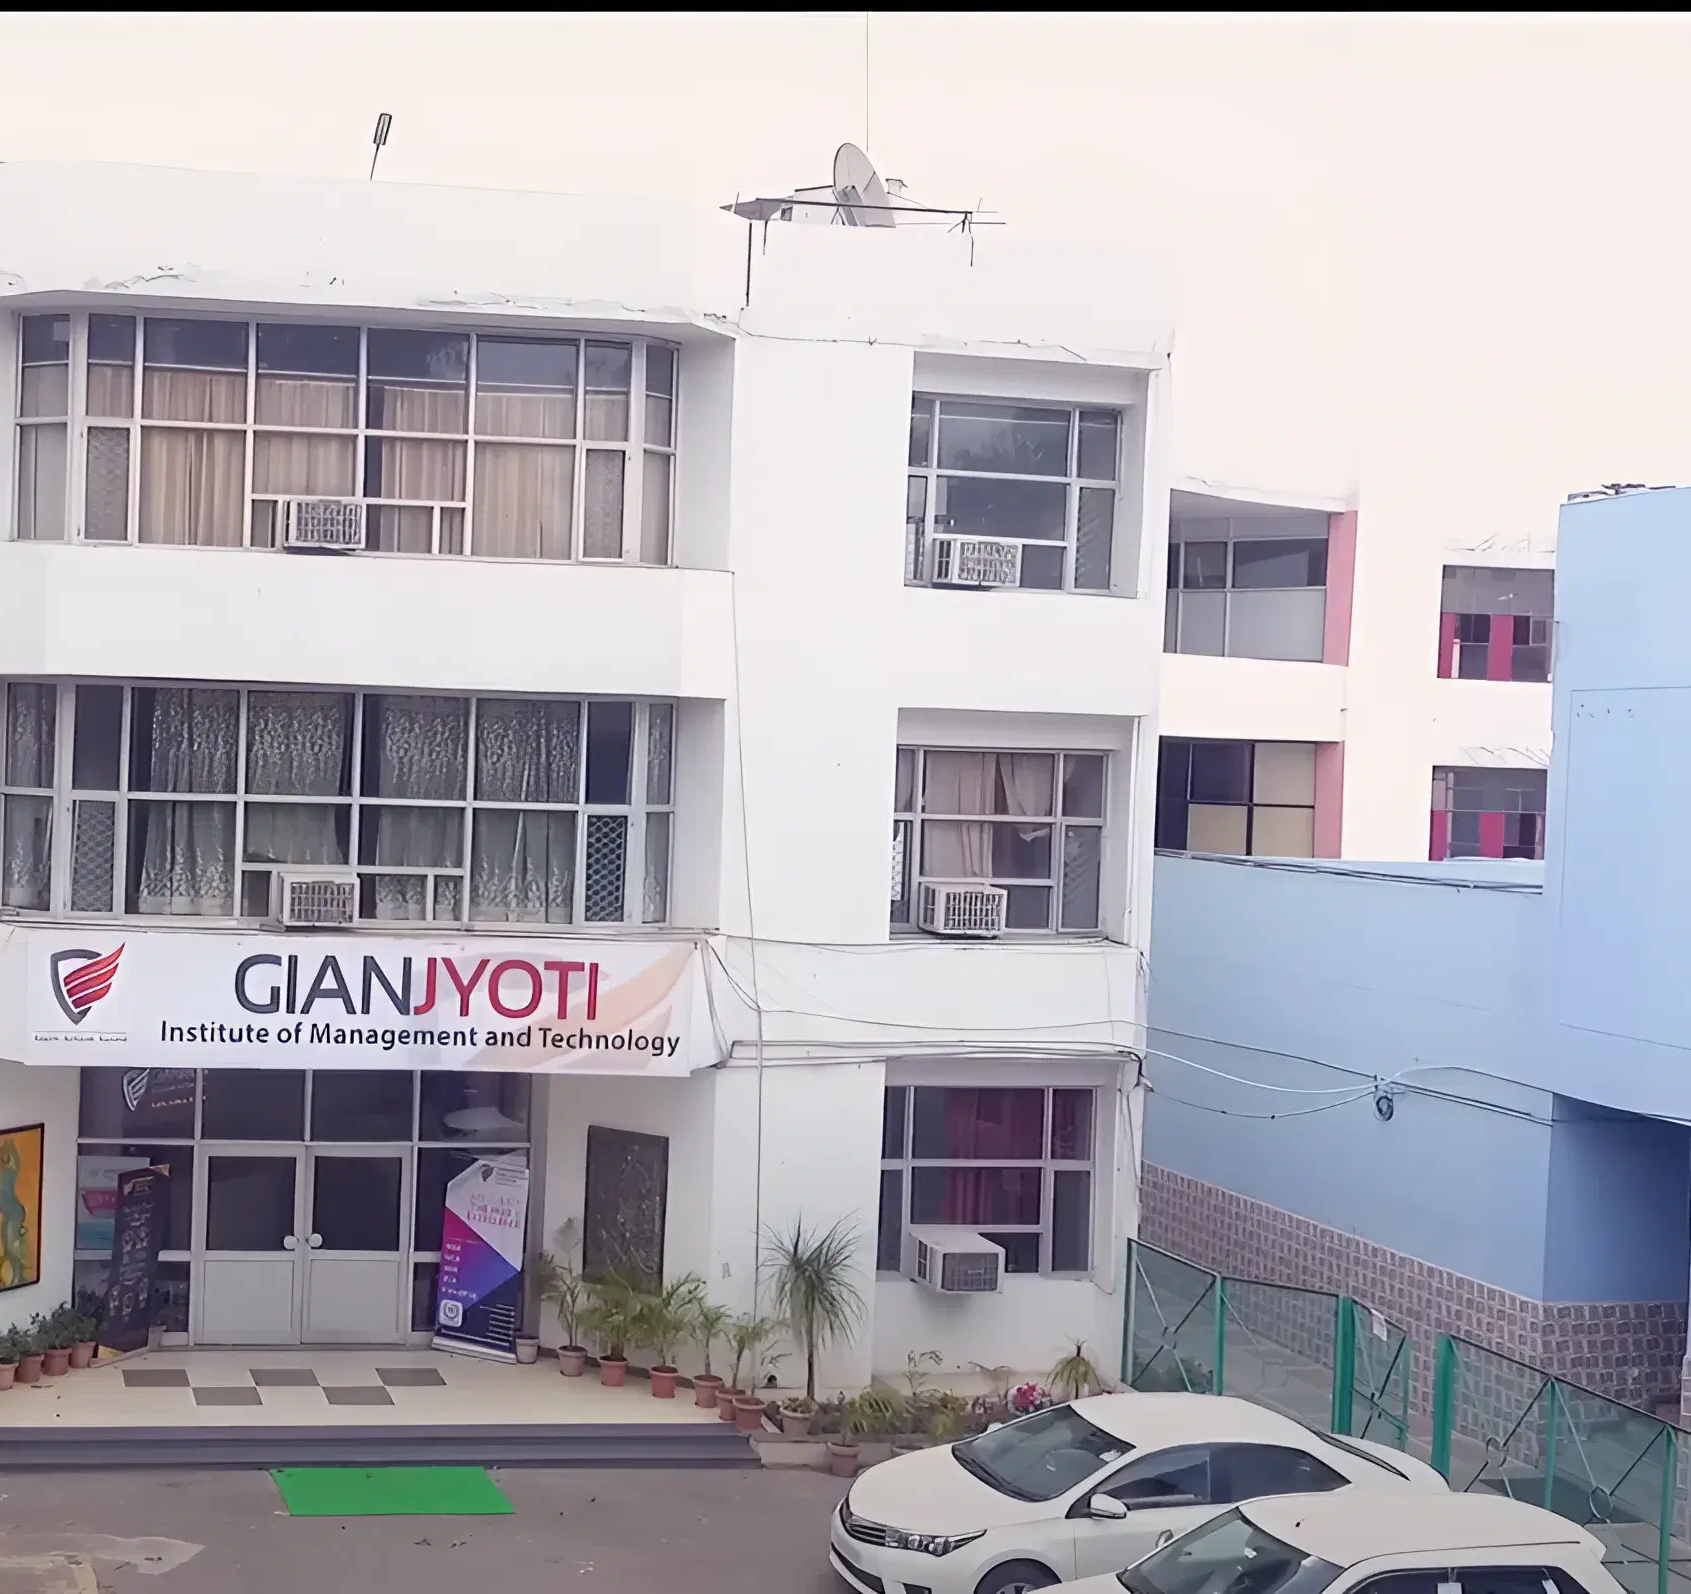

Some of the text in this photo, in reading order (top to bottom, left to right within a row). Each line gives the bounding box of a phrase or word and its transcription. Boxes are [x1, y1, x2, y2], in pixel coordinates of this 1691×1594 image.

[234, 953, 599, 1021] GIANJYOTI
[161, 1020, 680, 1057] Institute of Management and Technology
